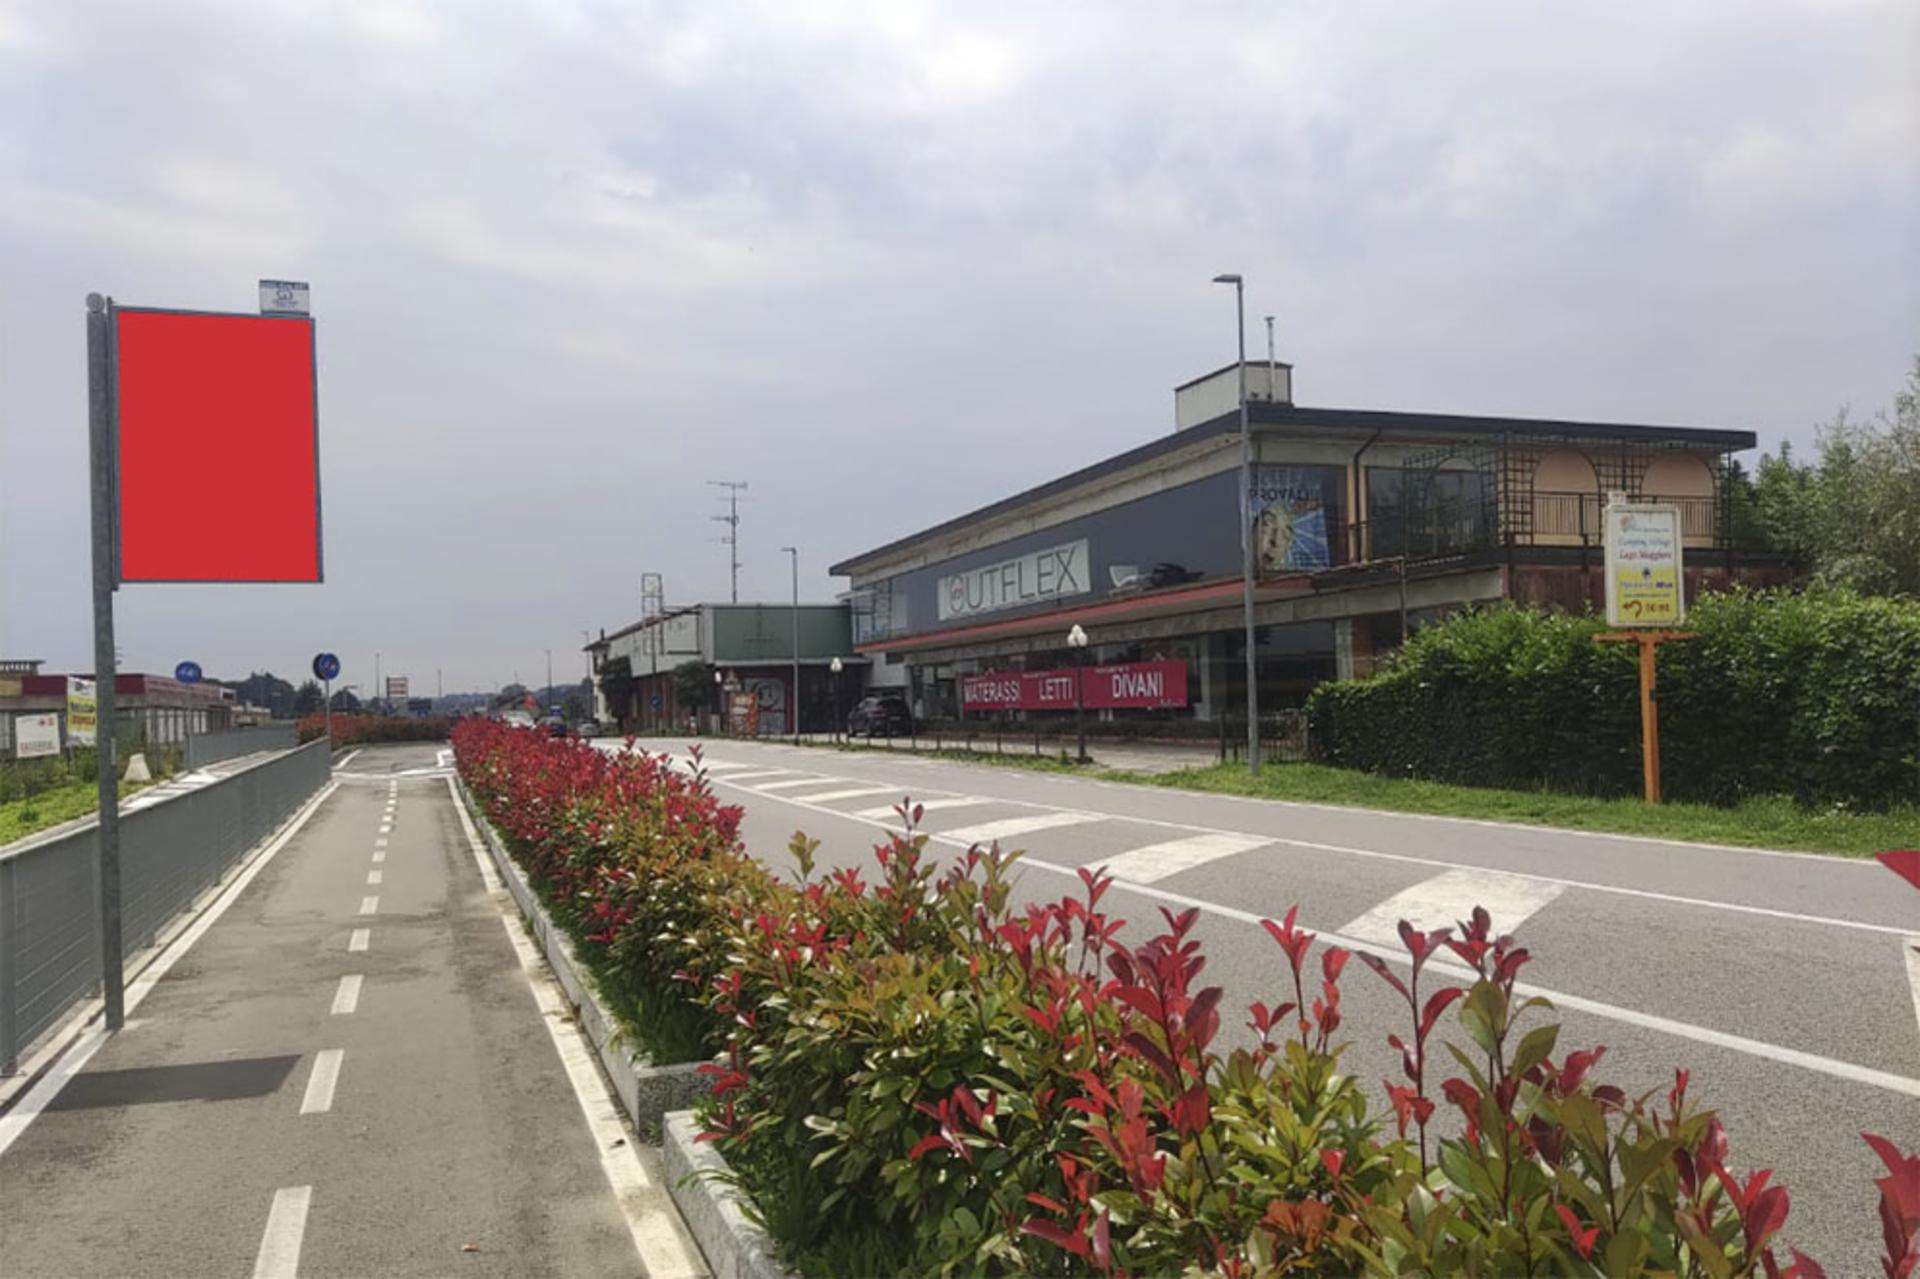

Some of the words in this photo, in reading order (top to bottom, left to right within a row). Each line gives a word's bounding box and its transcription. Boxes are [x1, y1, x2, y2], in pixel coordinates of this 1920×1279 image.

[949, 546, 1079, 613] OUTFLEX
[964, 681, 1019, 703] MATERASSI
[1040, 677, 1072, 700] LETTI
[1112, 671, 1163, 698] DIVANI
